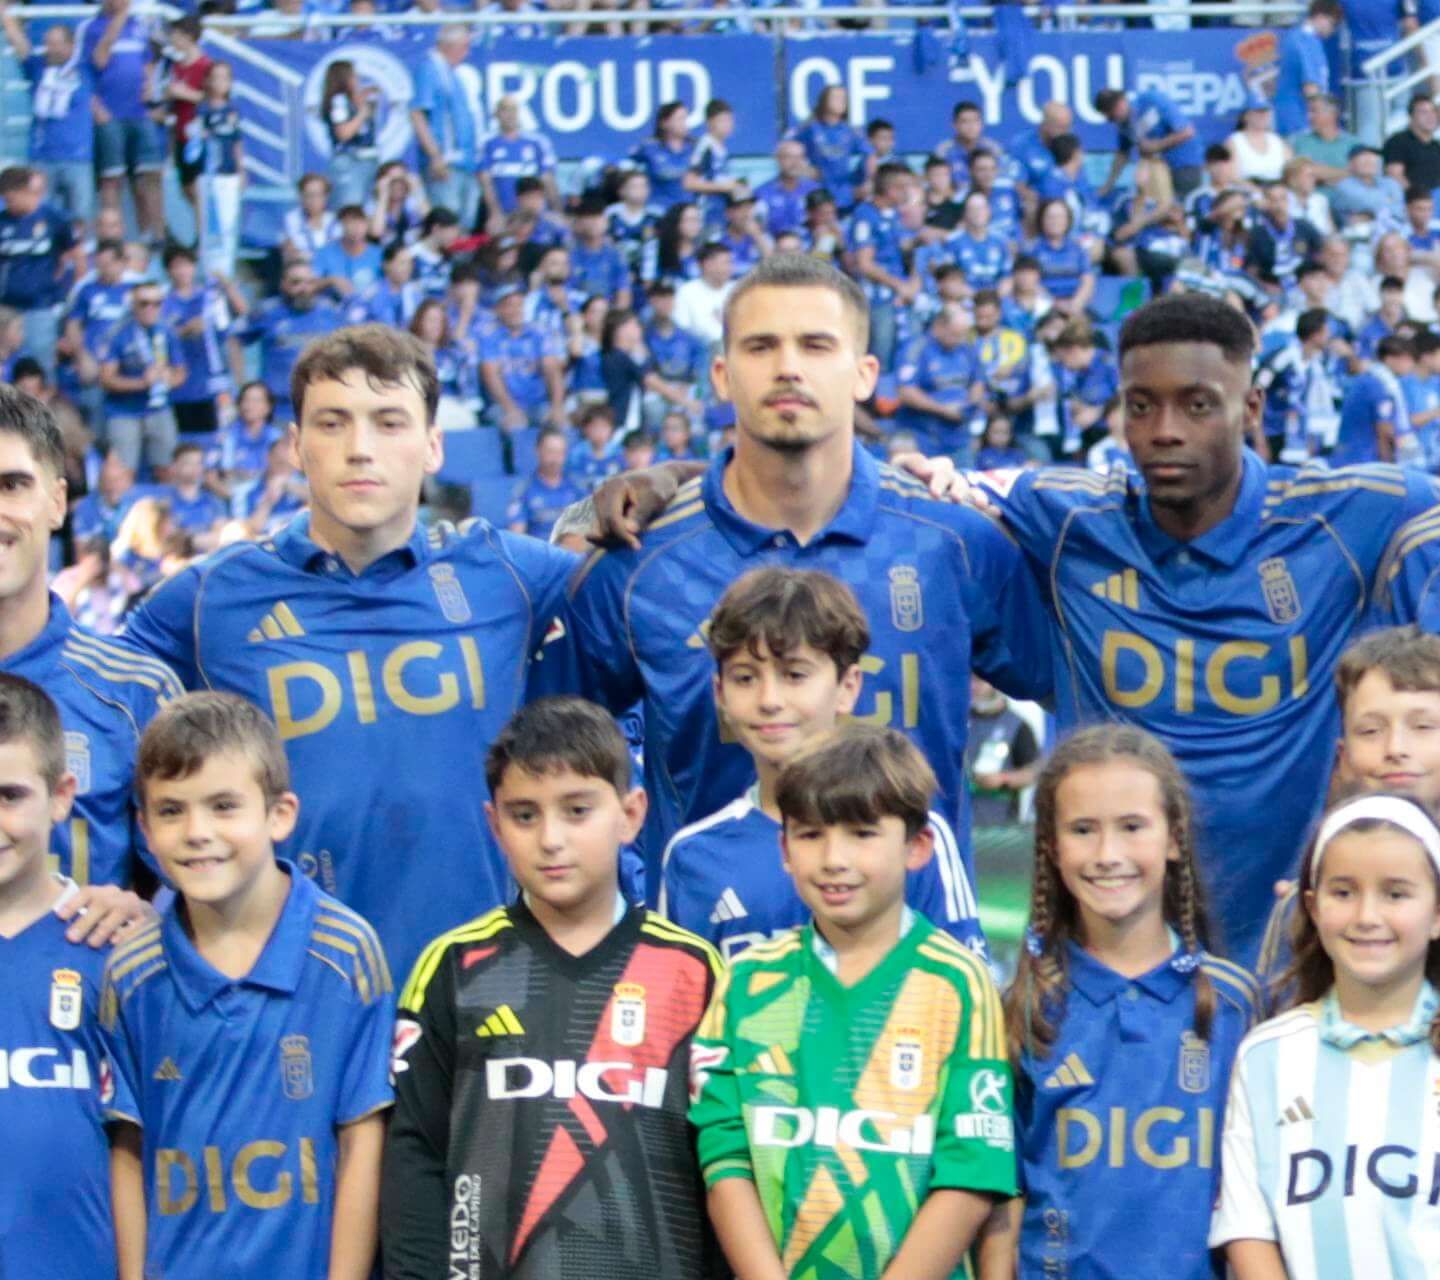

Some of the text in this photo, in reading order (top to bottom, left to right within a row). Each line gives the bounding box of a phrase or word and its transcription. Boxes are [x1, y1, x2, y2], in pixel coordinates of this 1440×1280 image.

[789, 55, 895, 128] OF
[949, 52, 1122, 125] YOU
[267, 635, 485, 740] DIGI
[1097, 629, 1311, 717] DIGI
[485, 1056, 668, 1108] DIGI
[752, 1104, 935, 1154] DIGI
[1053, 1106, 1214, 1169] DIGI
[155, 1136, 320, 1217] DIGI
